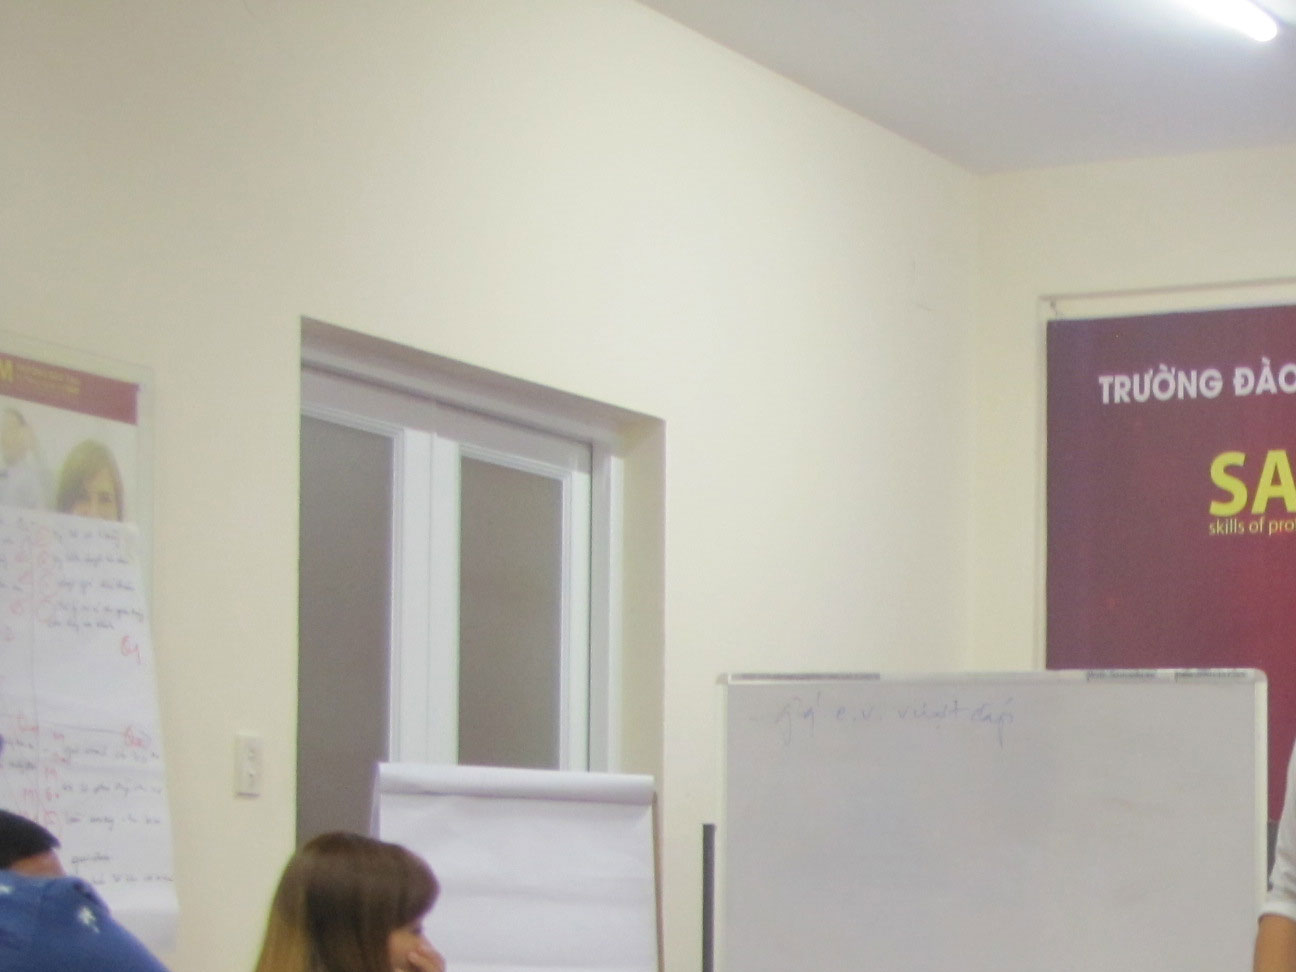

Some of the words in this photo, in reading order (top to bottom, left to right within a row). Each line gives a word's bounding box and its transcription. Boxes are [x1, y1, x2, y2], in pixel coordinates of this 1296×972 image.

[1098, 363, 1223, 404] TRƯỜNG
[1208, 518, 1245, 536] skills
[1249, 515, 1265, 534] of
